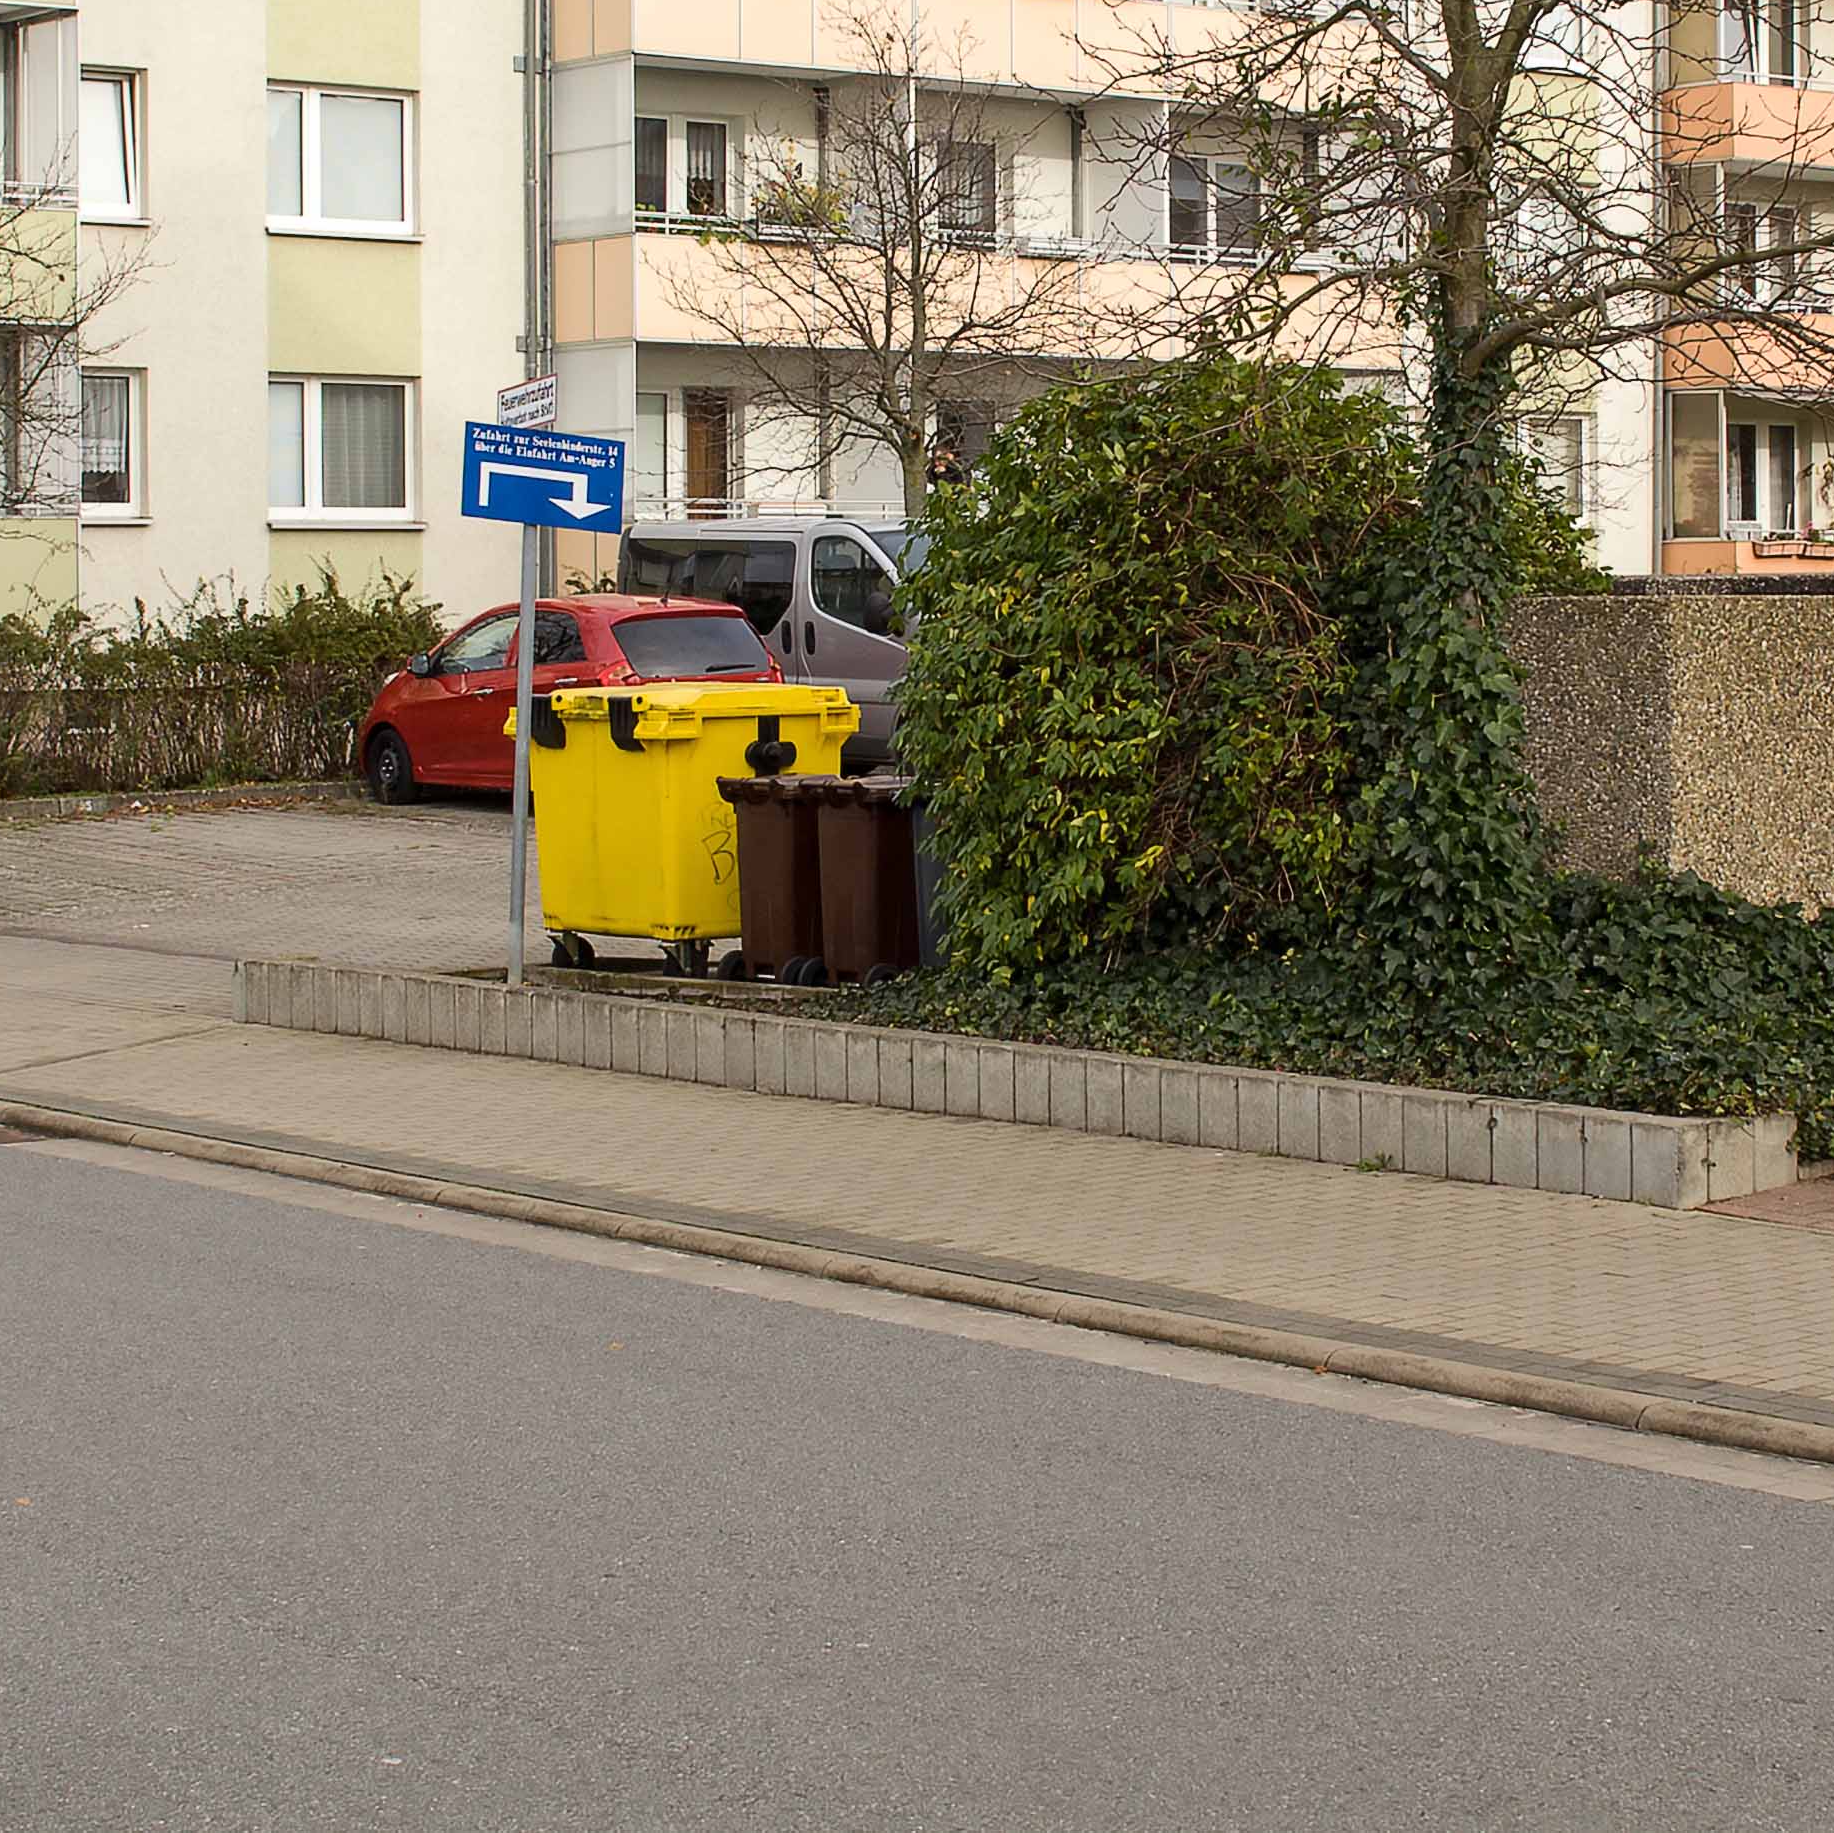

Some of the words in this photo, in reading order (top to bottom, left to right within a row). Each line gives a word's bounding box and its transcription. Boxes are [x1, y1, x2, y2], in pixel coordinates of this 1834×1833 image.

[472, 427, 510, 442] Zufahrt
[514, 436, 530, 445] zur
[608, 446, 618, 457] 14
[474, 441, 496, 454] über
[498, 443, 512, 455] die
[517, 446, 556, 462] Einfahrt
